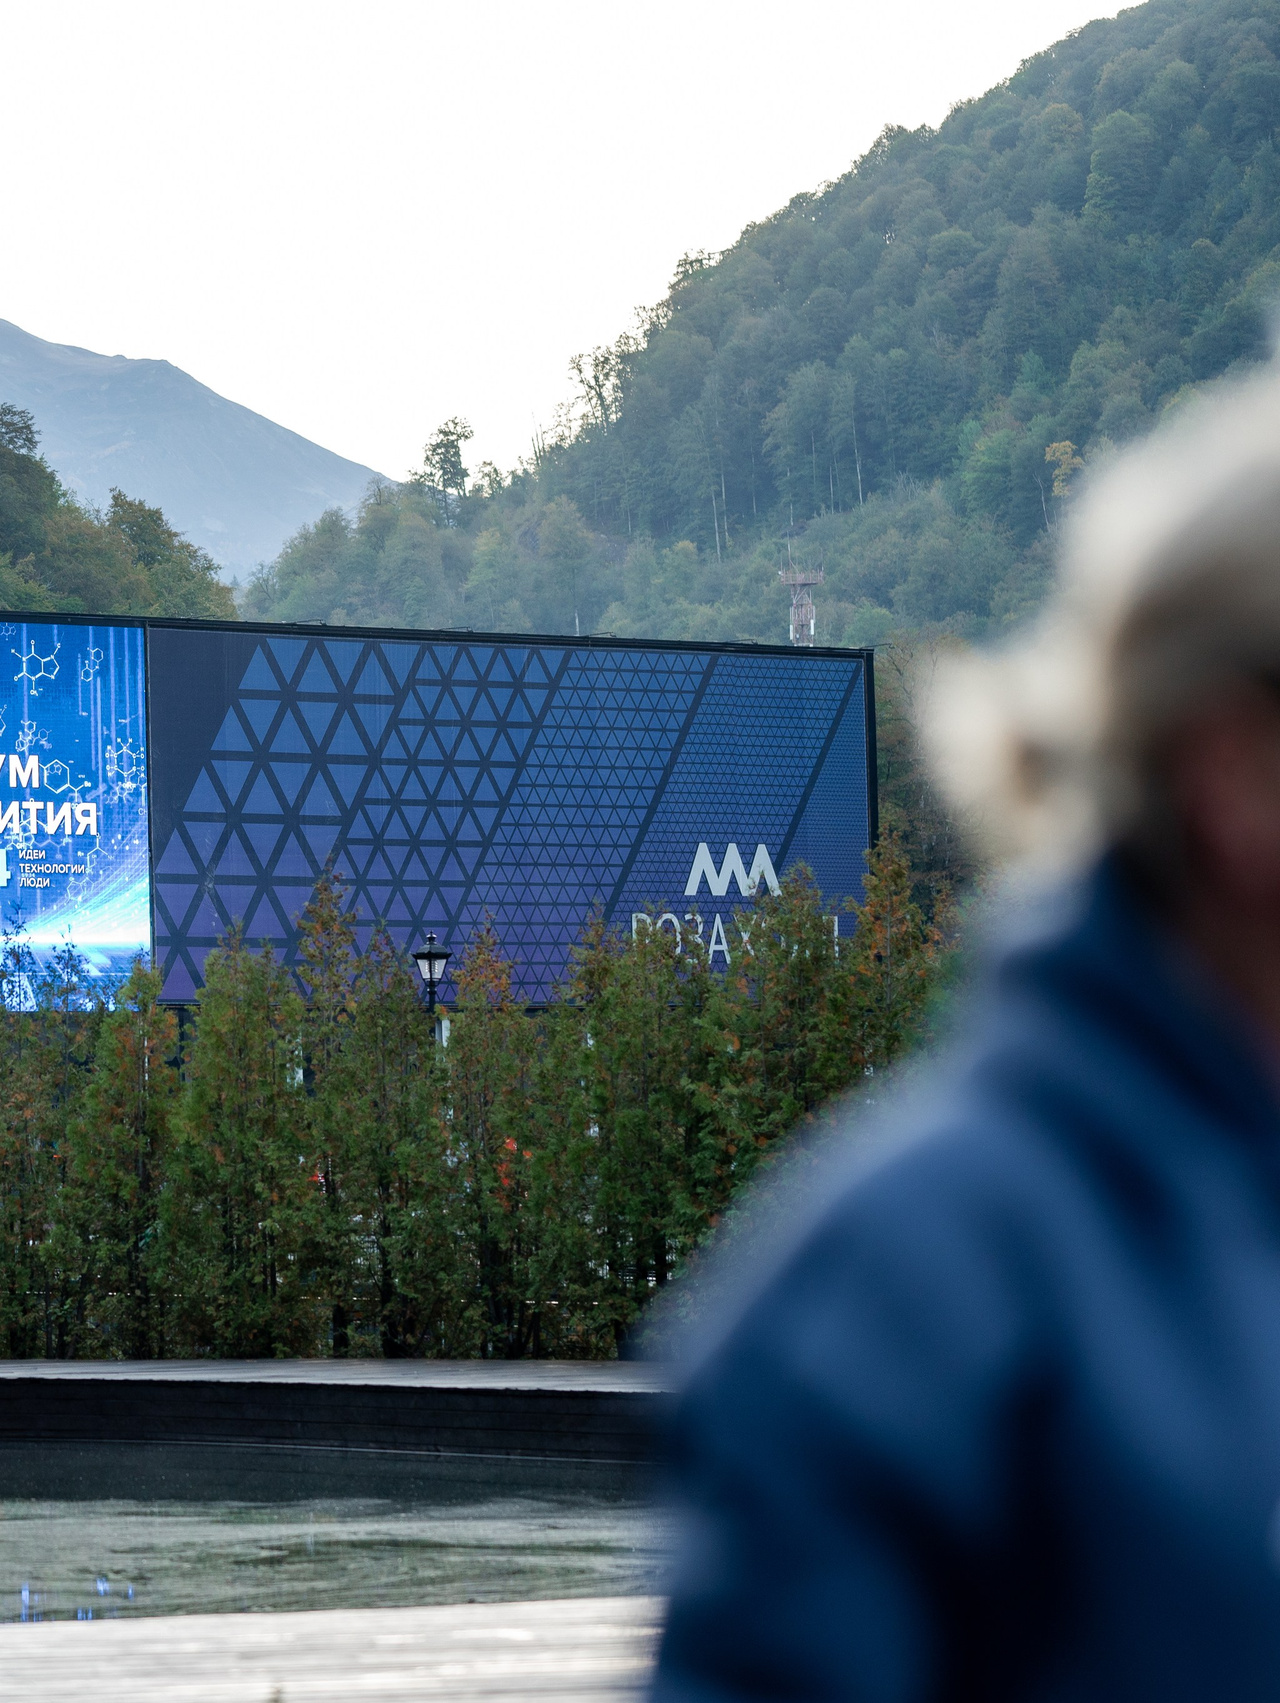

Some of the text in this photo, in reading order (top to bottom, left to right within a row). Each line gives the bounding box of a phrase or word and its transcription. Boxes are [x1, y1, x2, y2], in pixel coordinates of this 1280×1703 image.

[19, 850, 46, 860] ИДЕИ
[19, 863, 85, 874] ТЕХНОЛОГИИ
[20, 878, 50, 888] ЛЮДИ
